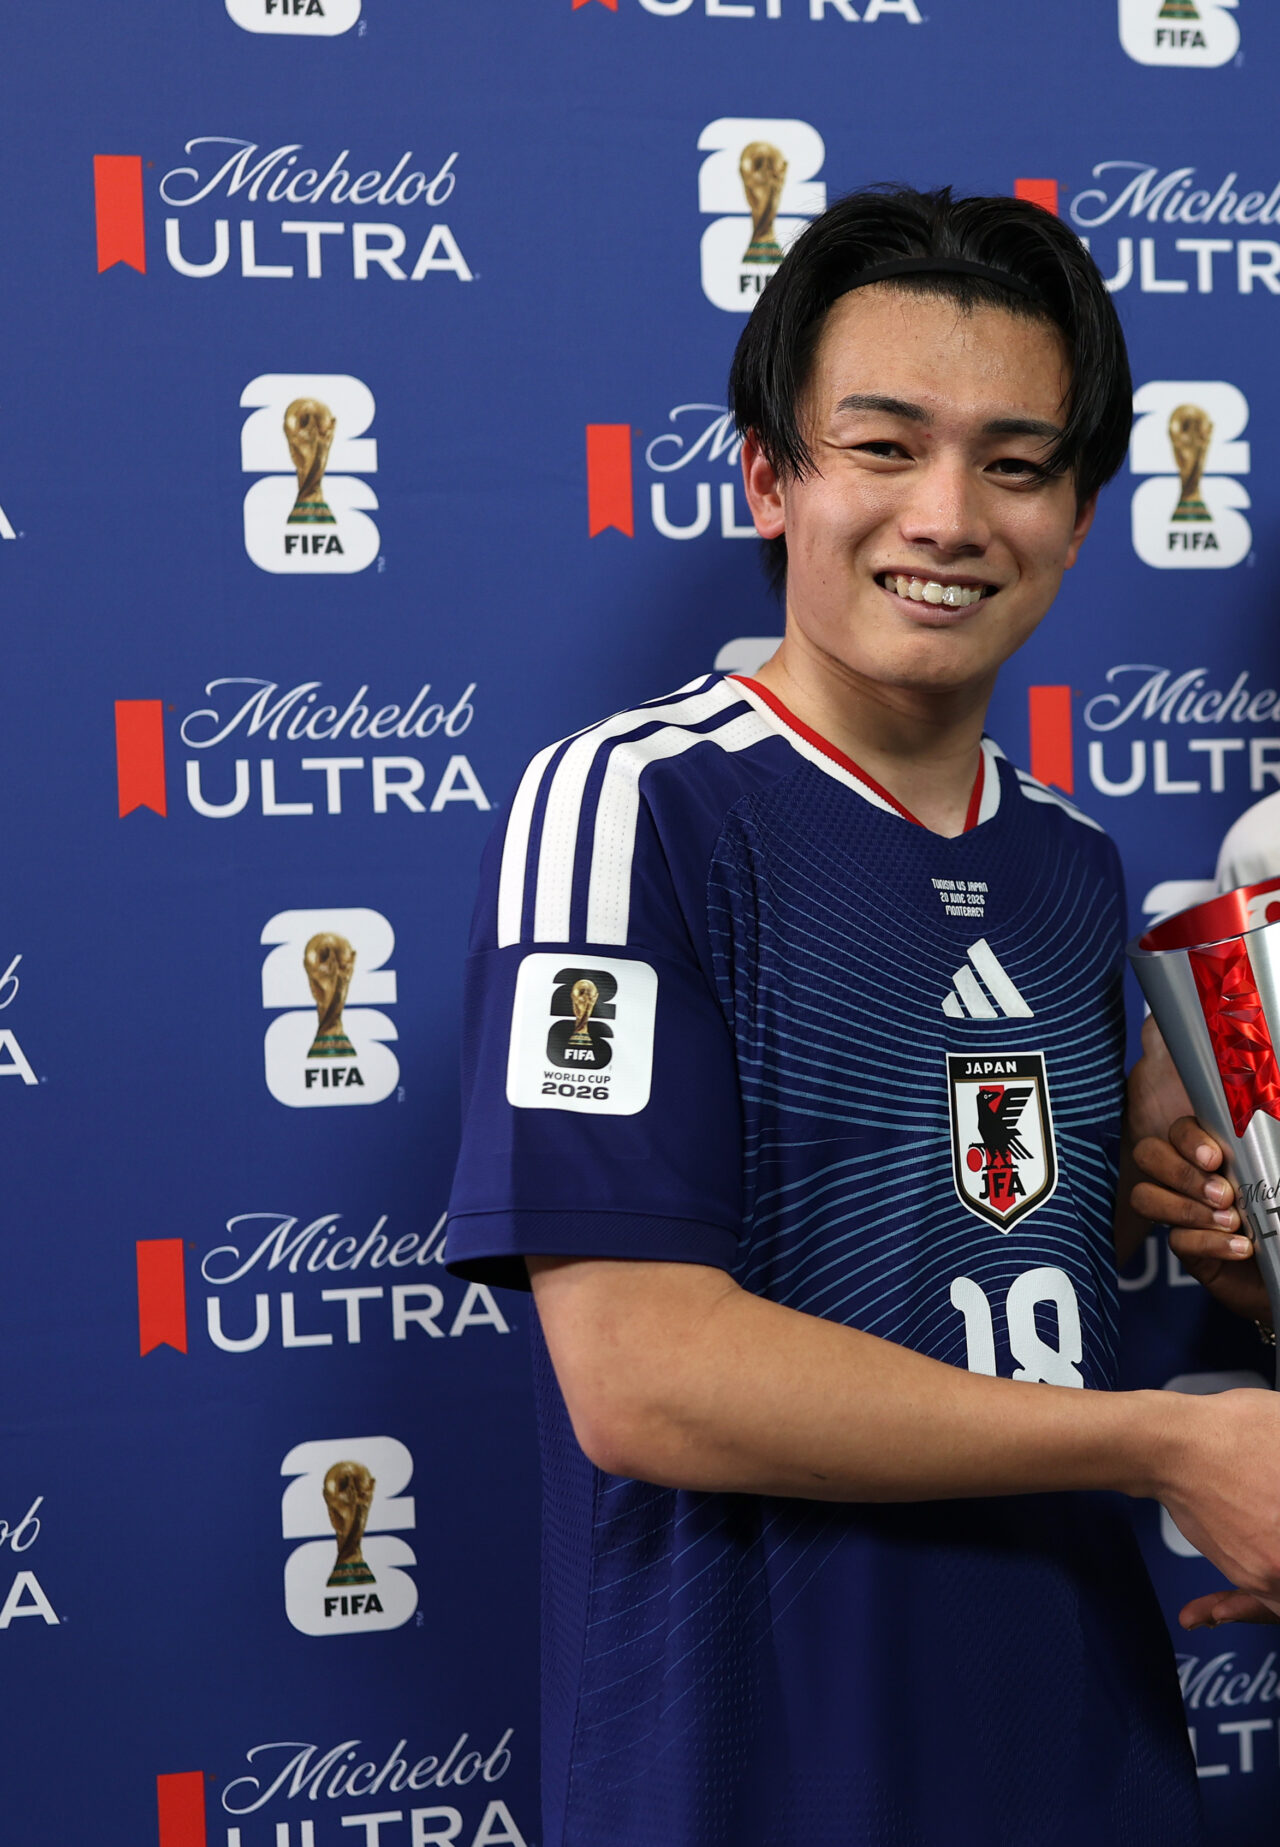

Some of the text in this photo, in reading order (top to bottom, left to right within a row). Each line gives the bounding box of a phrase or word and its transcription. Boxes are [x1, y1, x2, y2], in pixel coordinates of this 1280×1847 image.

[1156, 28, 1206, 48] FIFA
[160, 137, 458, 206] Michelob
[166, 218, 473, 281] ULTRA
[285, 534, 344, 555] FIFA
[1168, 532, 1219, 551] FIFA
[180, 677, 476, 748] Michelob
[186, 755, 491, 819] ULTRA
[940, 891, 949, 903] 20
[967, 893, 986, 905] 2026
[564, 1048, 596, 1061] FIFA
[305, 1067, 364, 1089] FIFA
[543, 1071, 611, 1084] WORLD CUP
[965, 1061, 1017, 1074] JAPAN
[541, 1082, 609, 1100] 2026
[979, 1172, 1026, 1200] JFA
[202, 1213, 447, 1285] Michel
[207, 1283, 510, 1353] ULTRA
[324, 1594, 384, 1617] FIFA
[222, 1728, 514, 1815] Michelob
